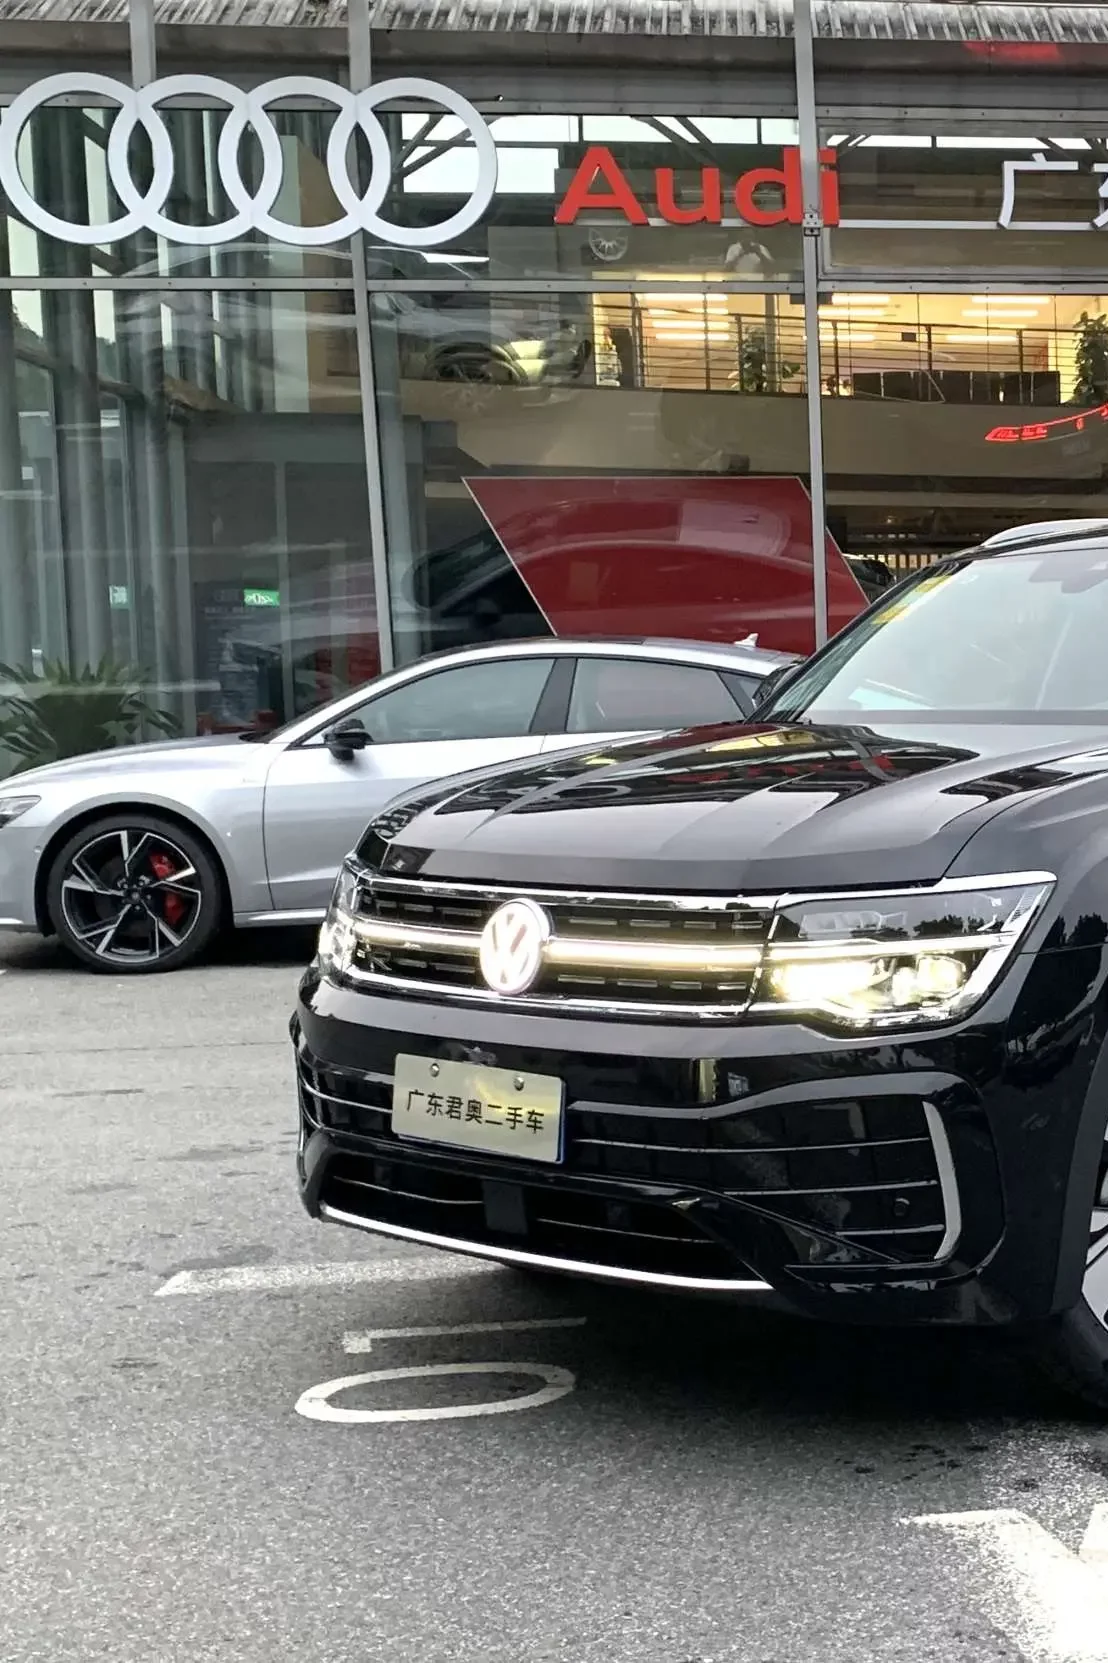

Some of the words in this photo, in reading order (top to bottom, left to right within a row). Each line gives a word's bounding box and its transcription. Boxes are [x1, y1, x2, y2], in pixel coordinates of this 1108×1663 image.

[554, 146, 839, 225] Audi
[406, 1088, 545, 1135] 广东君奥二手车
